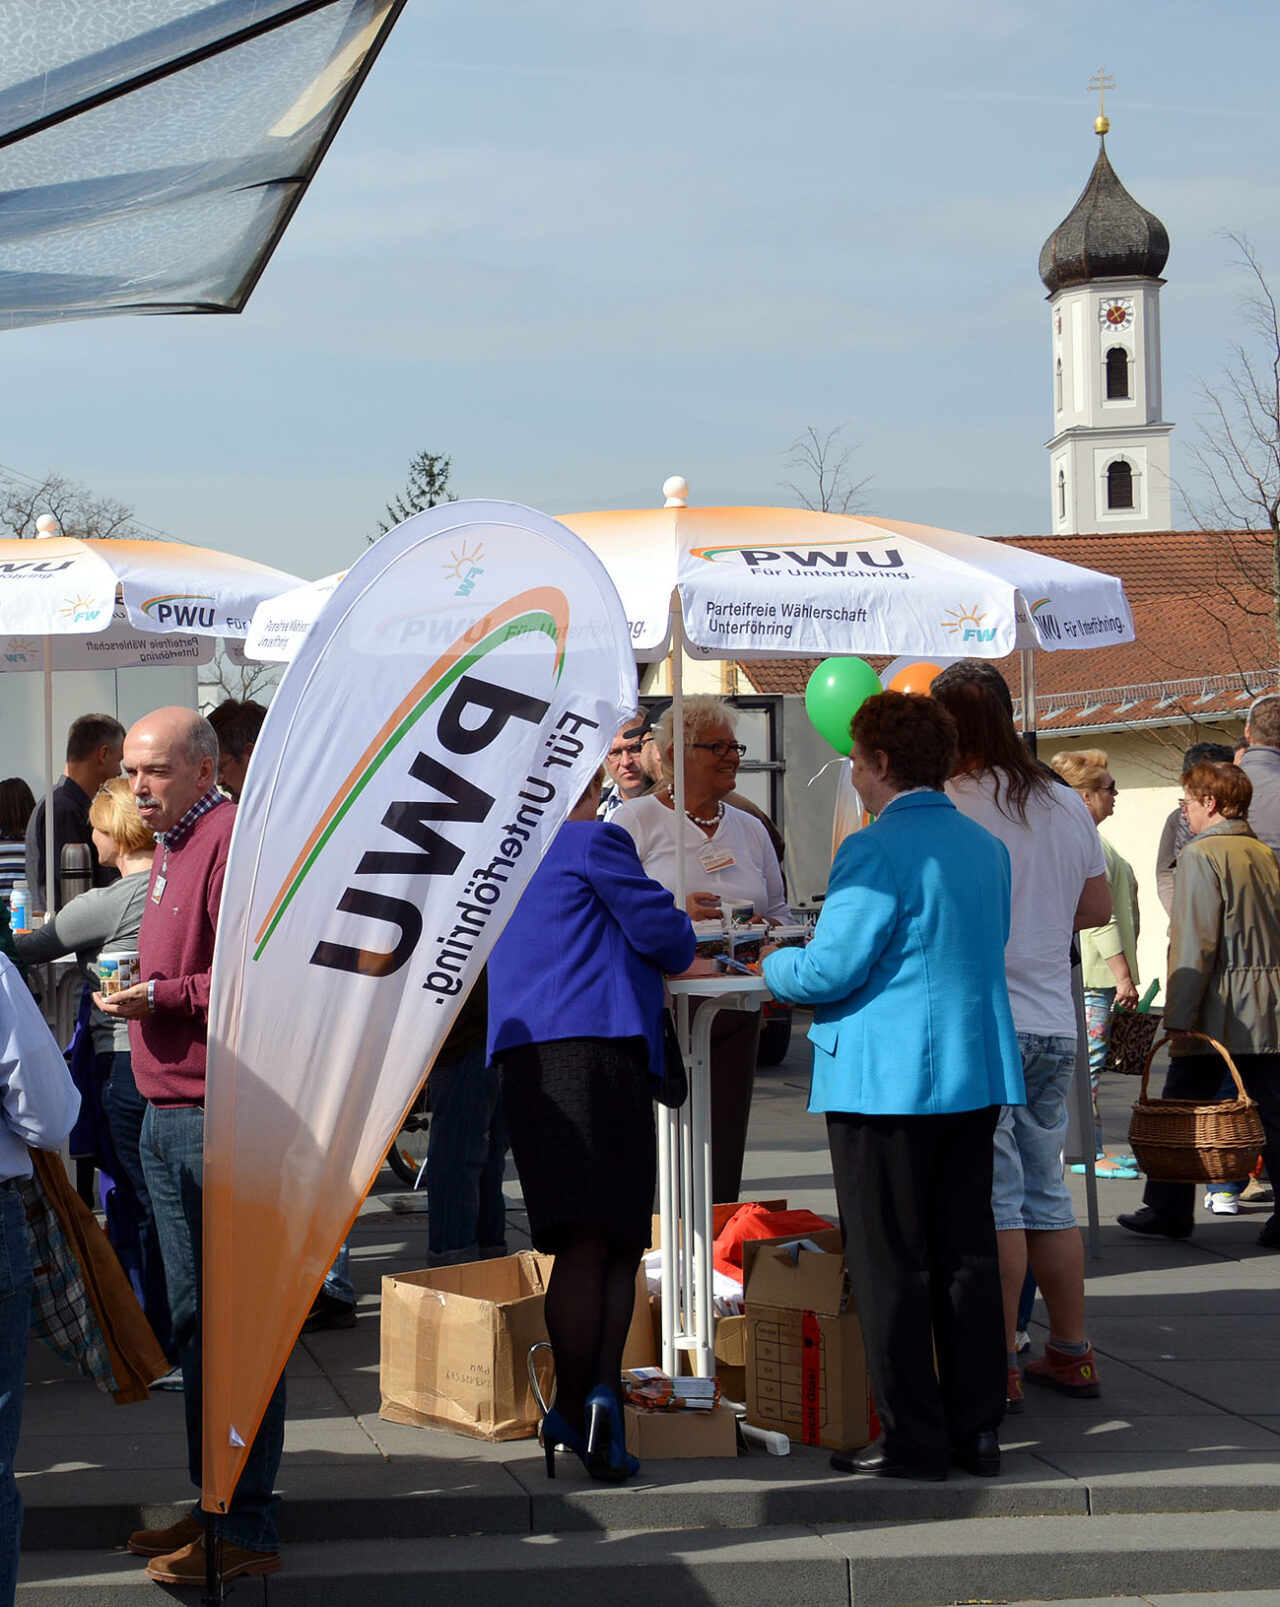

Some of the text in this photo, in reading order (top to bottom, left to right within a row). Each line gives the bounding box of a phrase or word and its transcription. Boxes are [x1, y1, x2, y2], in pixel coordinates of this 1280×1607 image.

[739, 549, 904, 569] PWU
[751, 567, 916, 580] Für Unterföhring.
[74, 611, 101, 623] FW
[158, 604, 215, 628] PWU
[226, 617, 247, 631] Für
[706, 601, 868, 623] Parteifreie Wählerschaft
[708, 619, 793, 638] Unterföhring
[962, 627, 998, 642] FW
[1033, 614, 1062, 640] WU
[1064, 621, 1078, 640] Für
